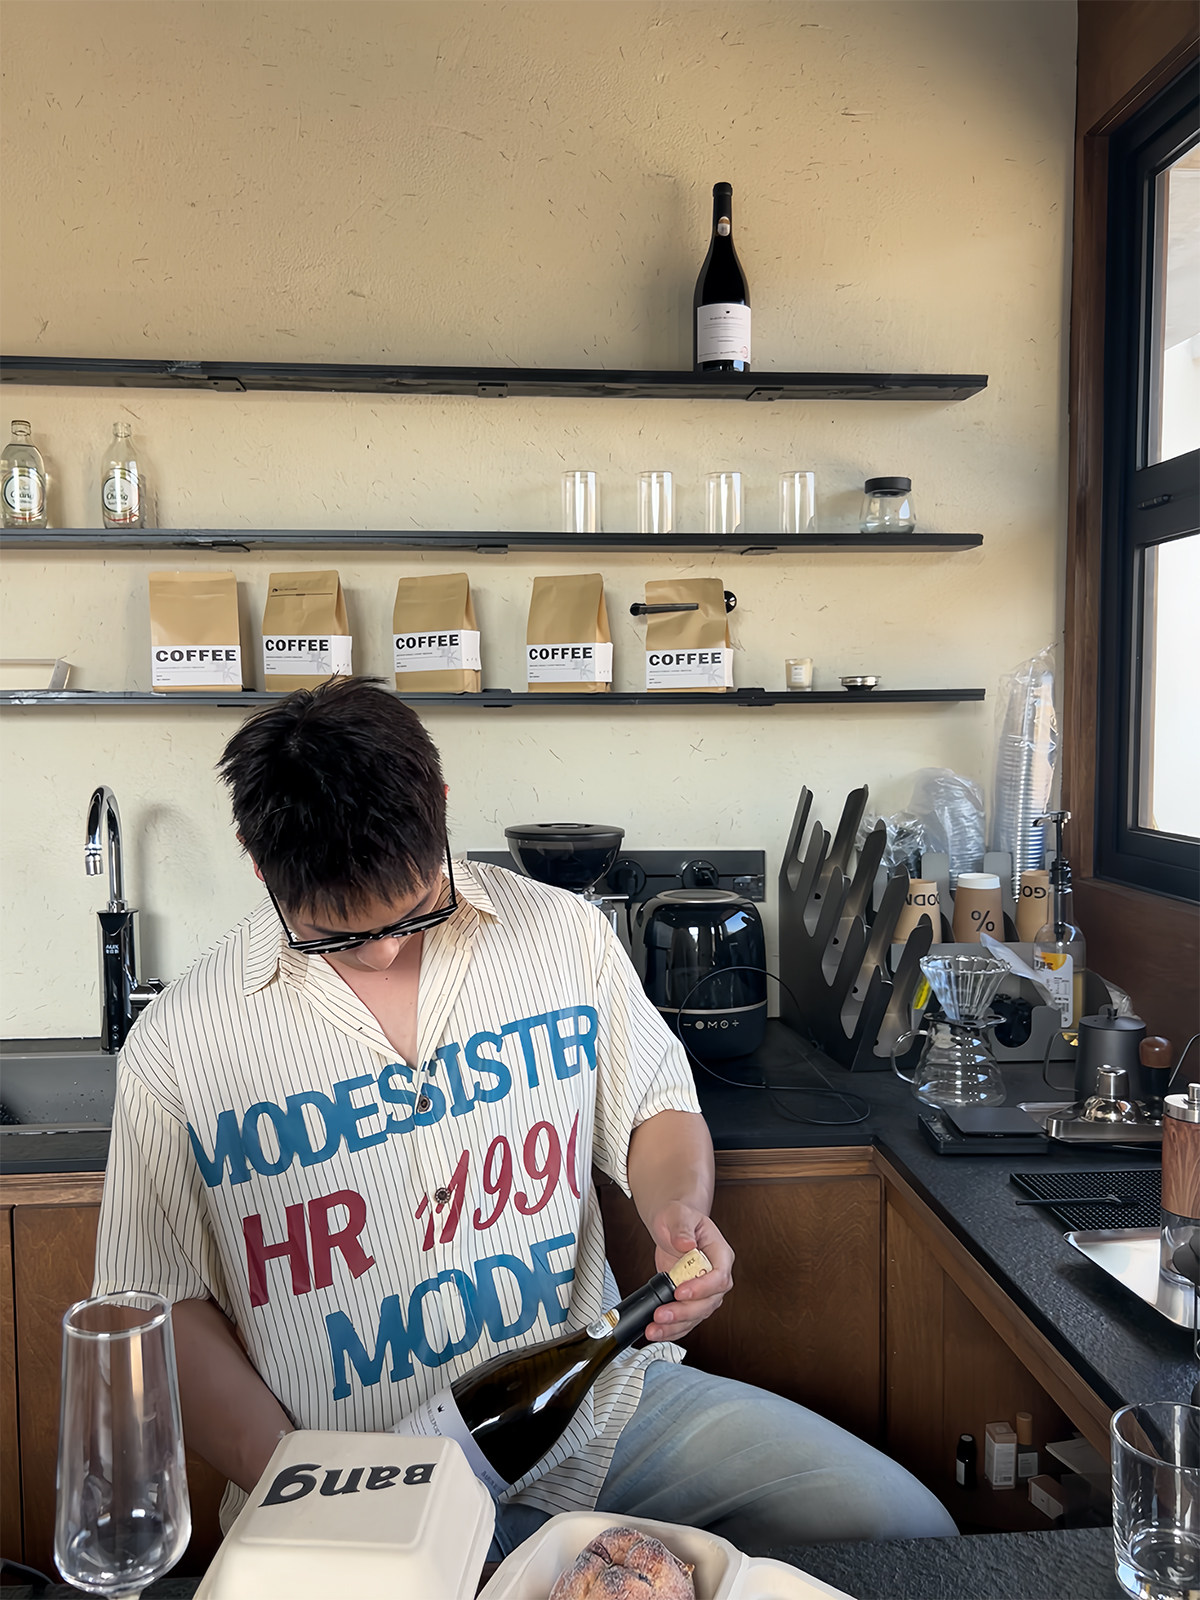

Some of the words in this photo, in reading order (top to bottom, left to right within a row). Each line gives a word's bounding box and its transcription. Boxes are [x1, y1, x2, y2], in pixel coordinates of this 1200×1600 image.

[265, 639, 329, 652] COFFEE
[395, 634, 460, 650] COFFEE
[156, 649, 237, 662] COFFEE
[529, 647, 593, 660] COFFEE
[648, 652, 722, 666] COFFEE
[1020, 885, 1047, 899] GO
[242, 1189, 376, 1308] HR
[325, 1232, 576, 1401] MODE
[258, 1463, 437, 1507] Bang
